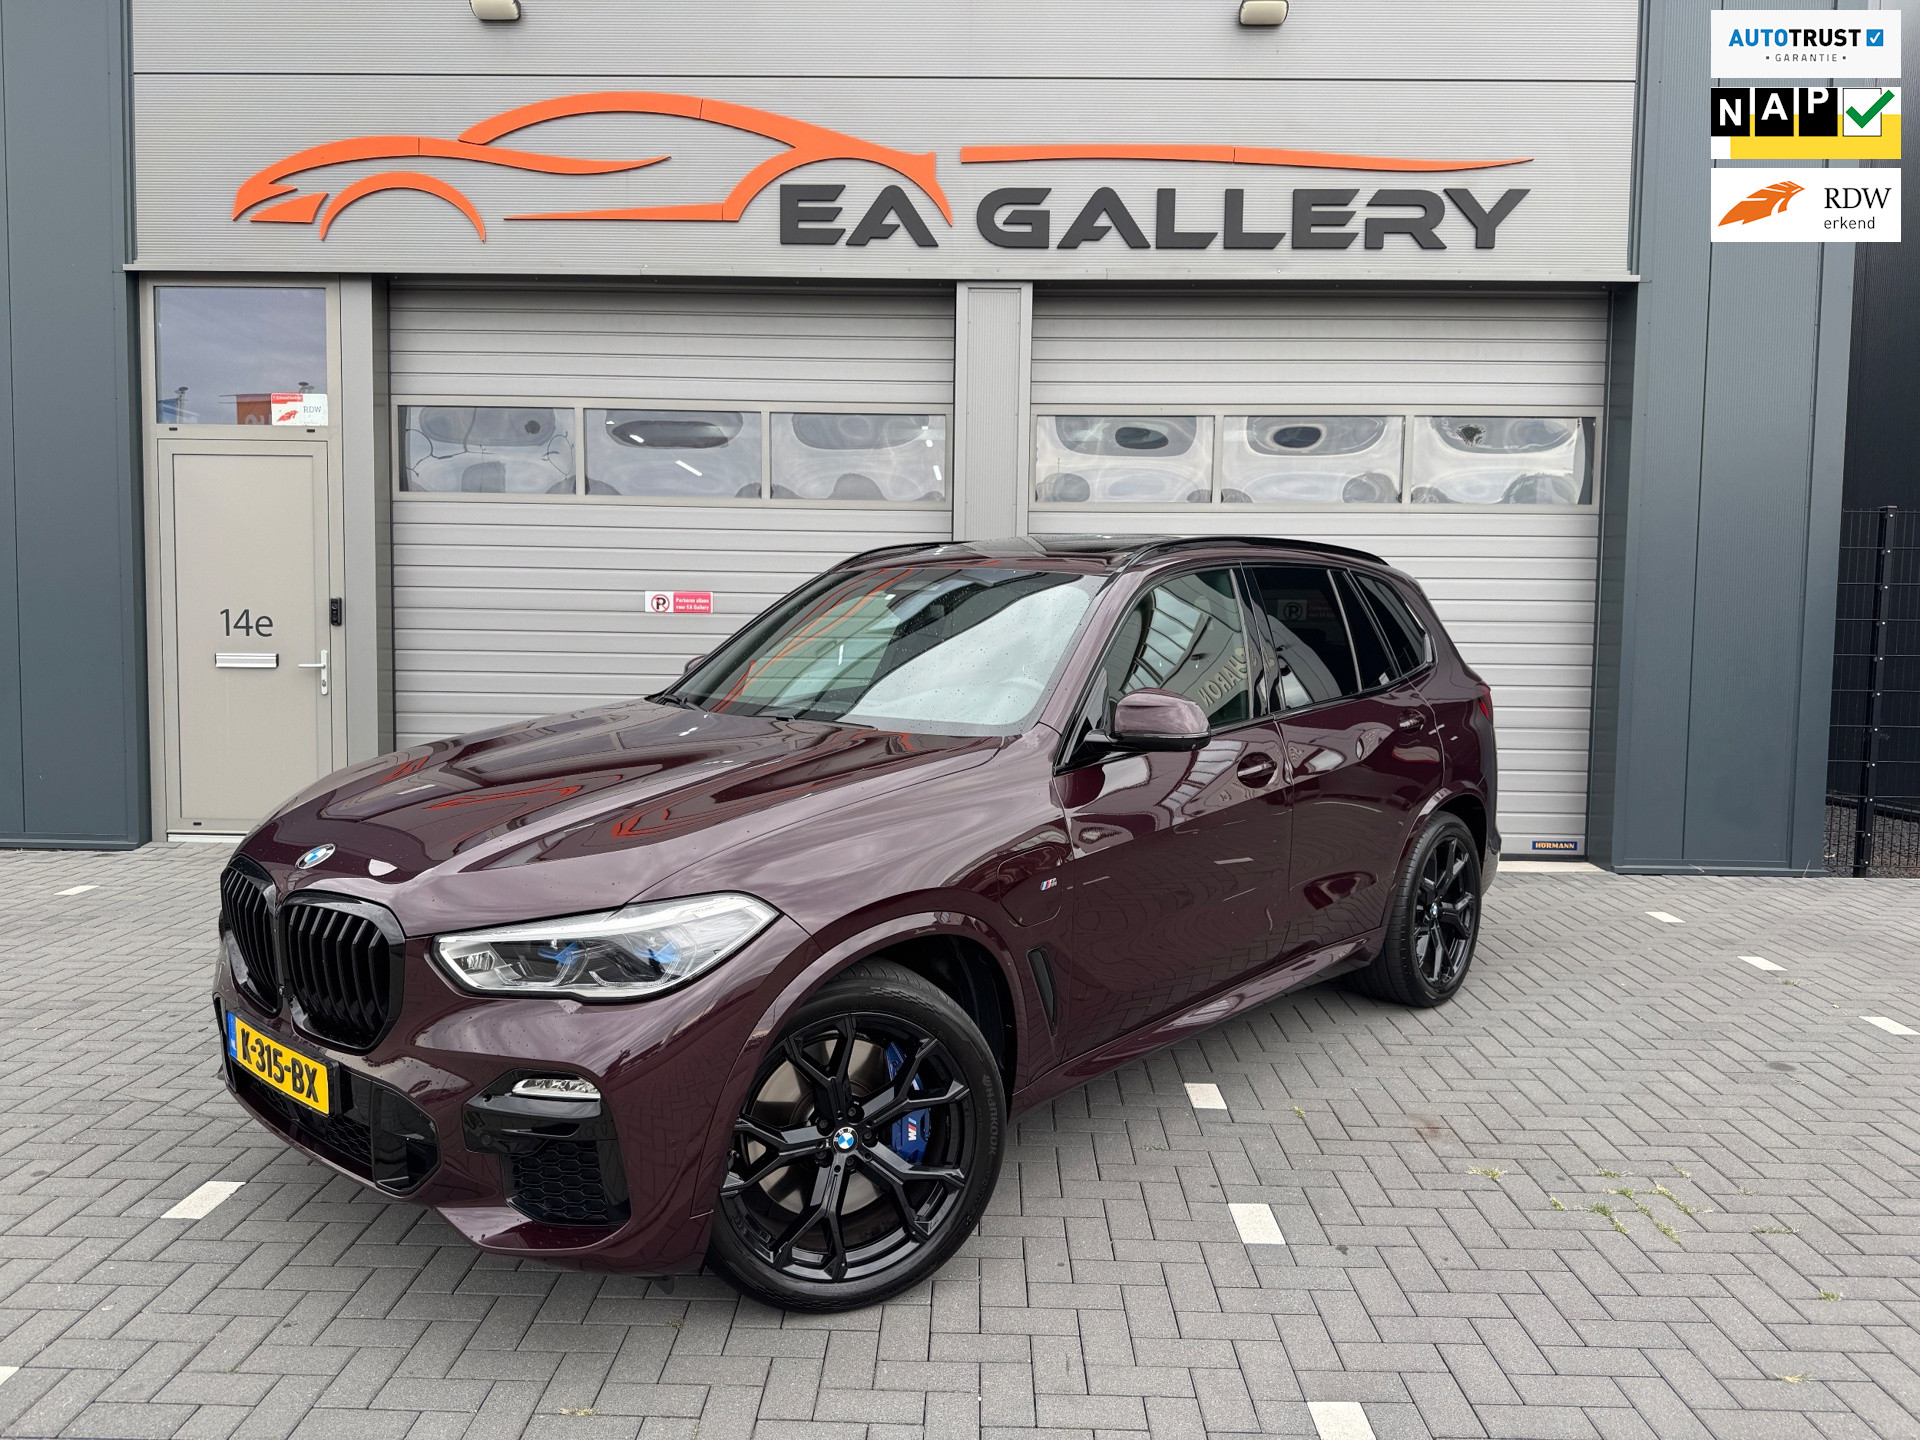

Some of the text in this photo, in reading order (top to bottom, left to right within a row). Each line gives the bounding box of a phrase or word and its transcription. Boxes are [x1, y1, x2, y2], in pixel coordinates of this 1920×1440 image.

[780, 184, 1531, 250] EA GALLERY
[303, 405, 322, 414] RDW
[220, 608, 273, 637] 14e
[240, 1028, 319, 1103] K-315-BX
